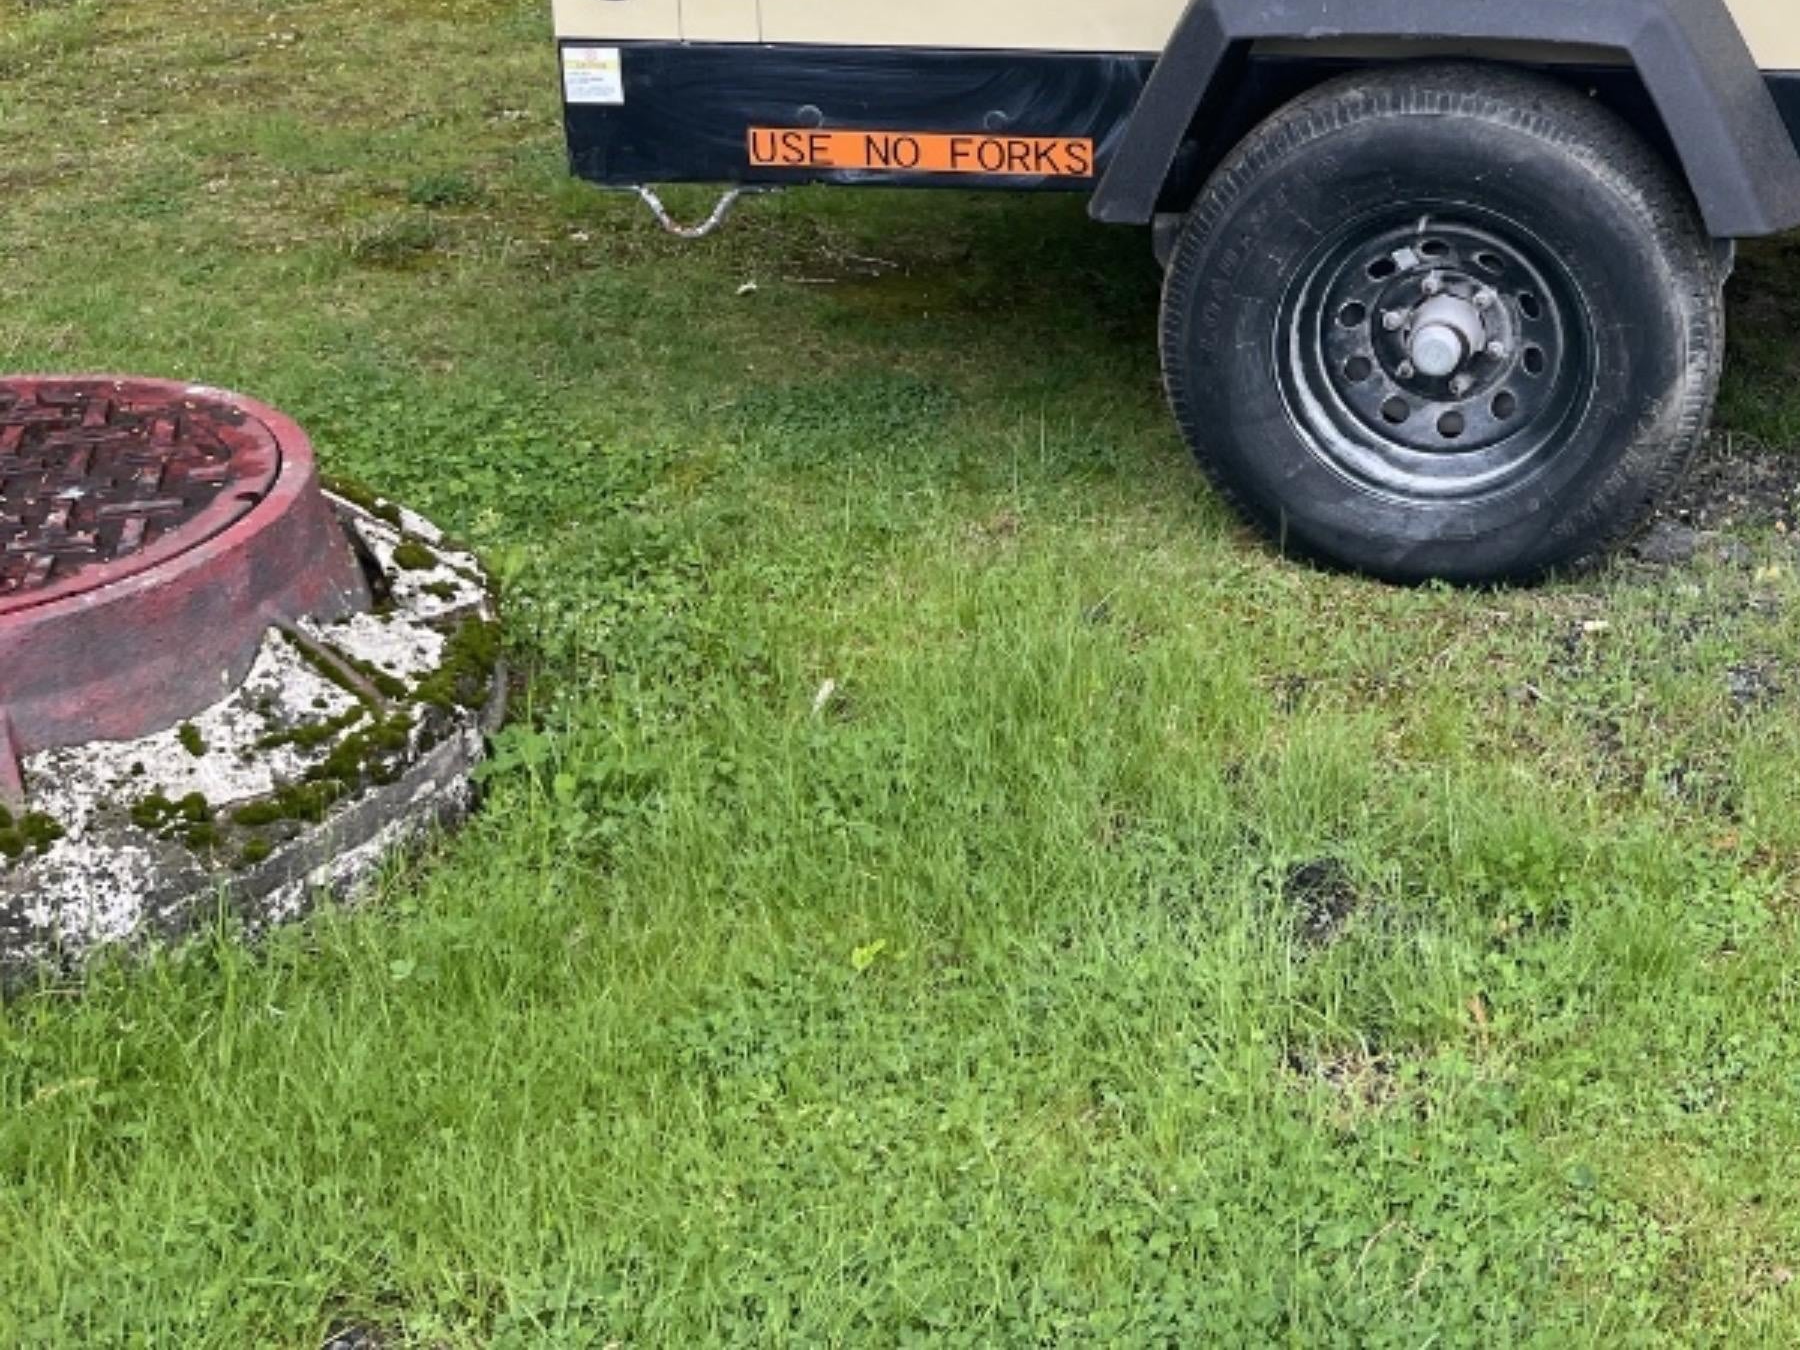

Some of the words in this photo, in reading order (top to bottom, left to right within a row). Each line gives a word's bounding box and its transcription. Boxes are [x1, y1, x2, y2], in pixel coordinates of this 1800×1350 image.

[752, 131, 833, 166] USE
[865, 134, 919, 168] NO
[950, 138, 1089, 175] FORKS
